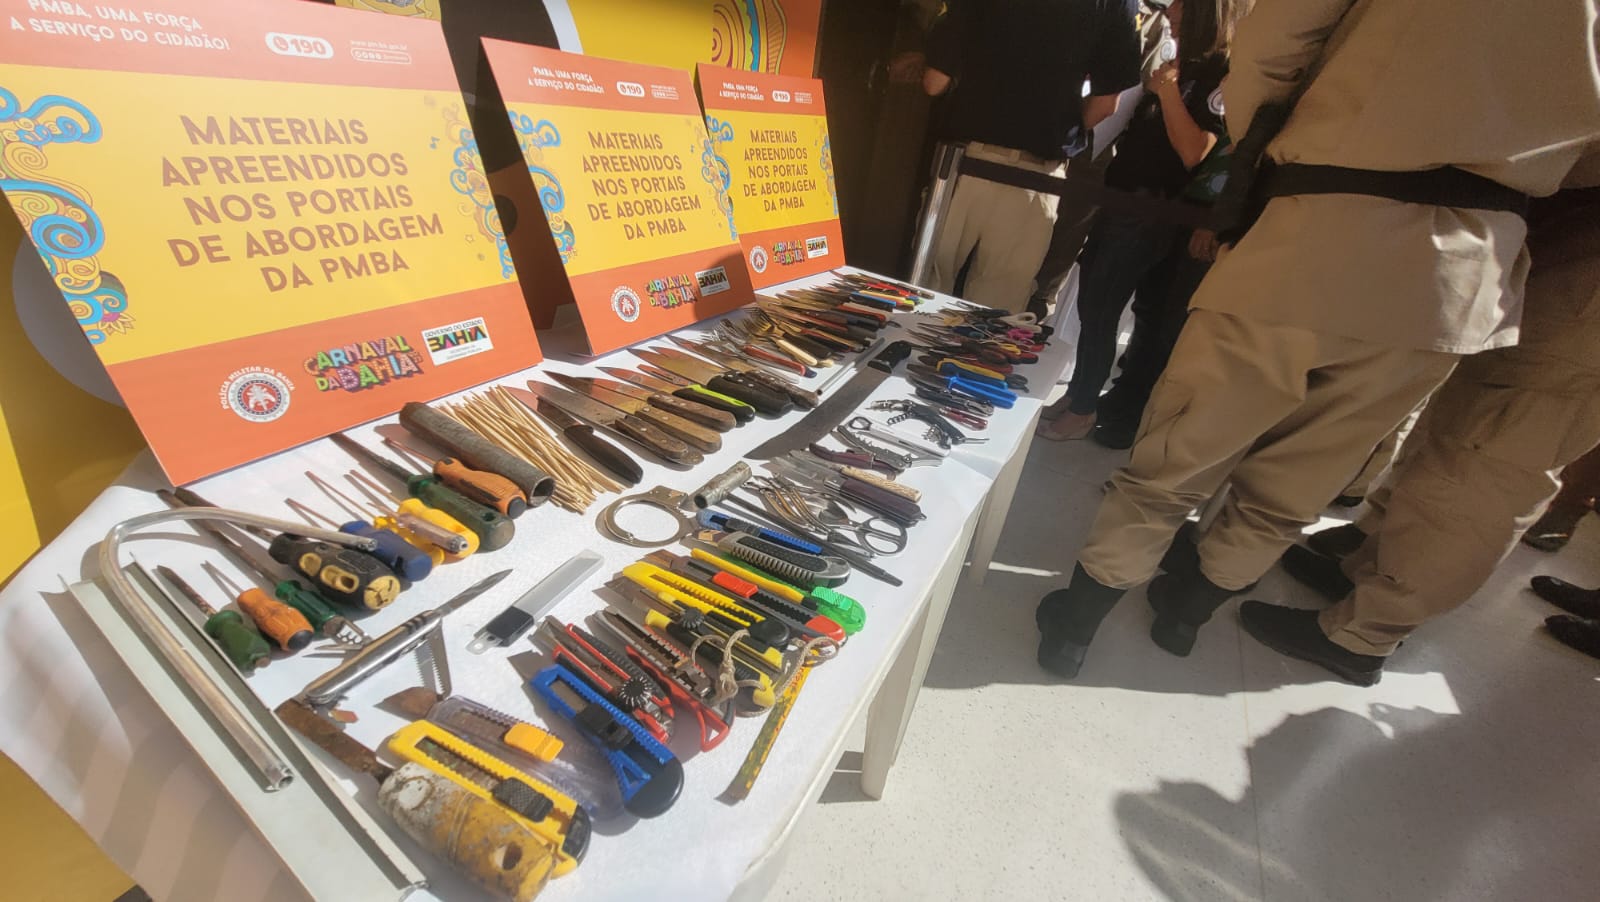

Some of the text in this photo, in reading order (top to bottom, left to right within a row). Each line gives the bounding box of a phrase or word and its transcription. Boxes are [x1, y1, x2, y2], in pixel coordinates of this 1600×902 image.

[27, 0, 203, 32] PMBA, UMA FORÇA
[10, 17, 231, 50] A SERVIÇO DO CIDADÃO!
[290, 38, 327, 55] 190
[534, 78, 564, 91] SERVIÇO
[563, 81, 575, 90] DO
[555, 69, 572, 80] UMA
[571, 71, 593, 83] FORÇA
[626, 84, 642, 95] 190
[180, 115, 369, 145] MATERIAIS
[588, 131, 663, 150] MATERIAIS
[750, 129, 798, 144] MATERIAIS
[583, 155, 682, 173] APREENDIDOS
[744, 147, 808, 162] APREENDIDOS
[162, 152, 408, 187] APREENDIDOS
[748, 163, 809, 179] NOS PORTAIS
[592, 175, 686, 196] NOS PORTAIS
[743, 178, 817, 197] DE ABORDAGEM
[183, 184, 413, 225] NOS PORTAIS
[587, 195, 701, 221] DE ABORDAGEM
[764, 197, 805, 212] DA PMBA
[624, 218, 687, 240] DA PMBA
[167, 213, 444, 268] DE ABORDAGEM
[260, 249, 410, 293] DA PMBA
[453, 323, 462, 331] DO
[426, 324, 488, 353] BAHIA
[303, 335, 411, 377] CARNAVAL
[316, 374, 340, 392] DA
[337, 353, 419, 391] BAHIA
